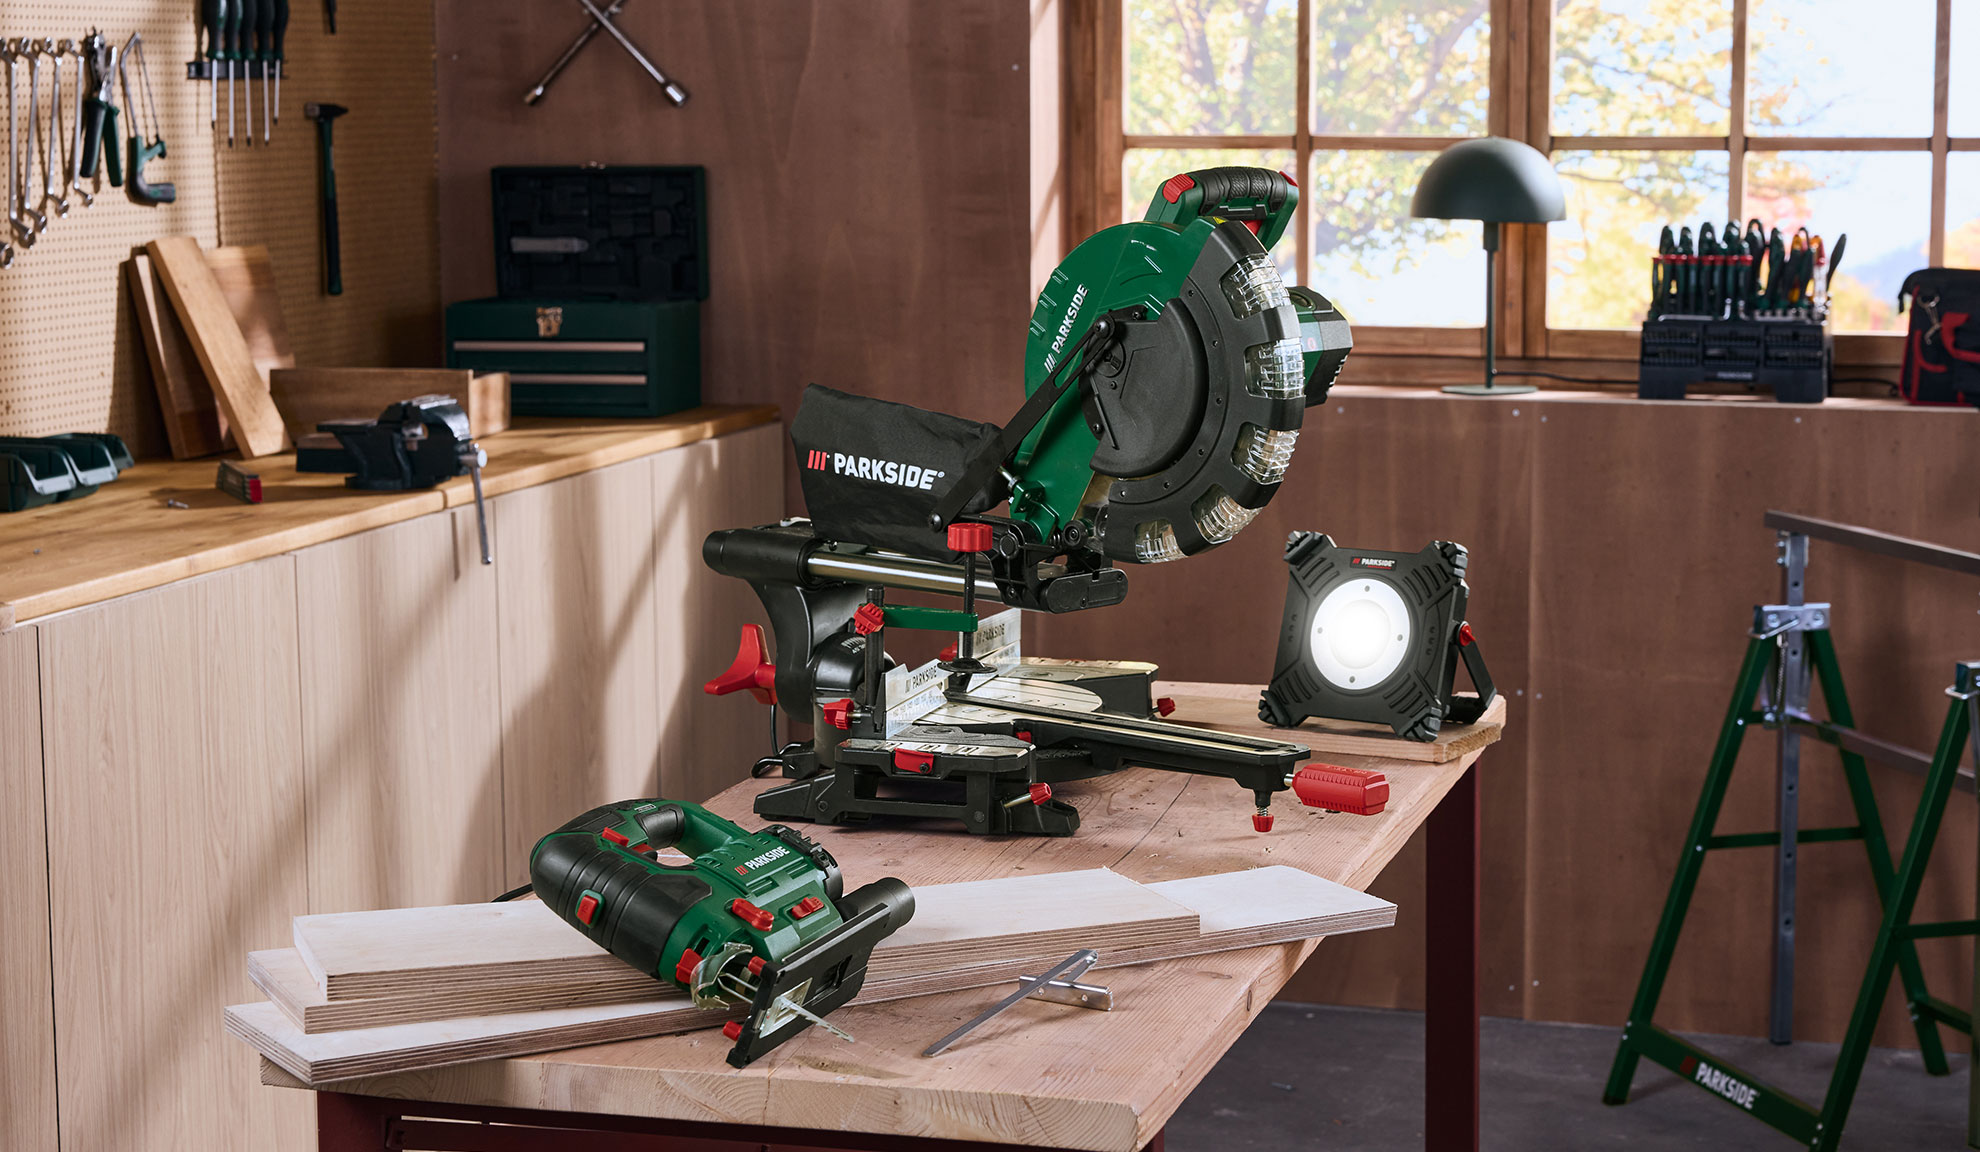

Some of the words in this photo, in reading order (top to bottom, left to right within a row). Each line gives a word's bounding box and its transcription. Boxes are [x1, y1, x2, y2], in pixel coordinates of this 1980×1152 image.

[1052, 284, 1088, 353] PARKSIDE
[913, 665, 937, 689] PARKSIDE
[744, 846, 790, 870] PARKSIDE
[1696, 1062, 1756, 1109] PARKSIDE
